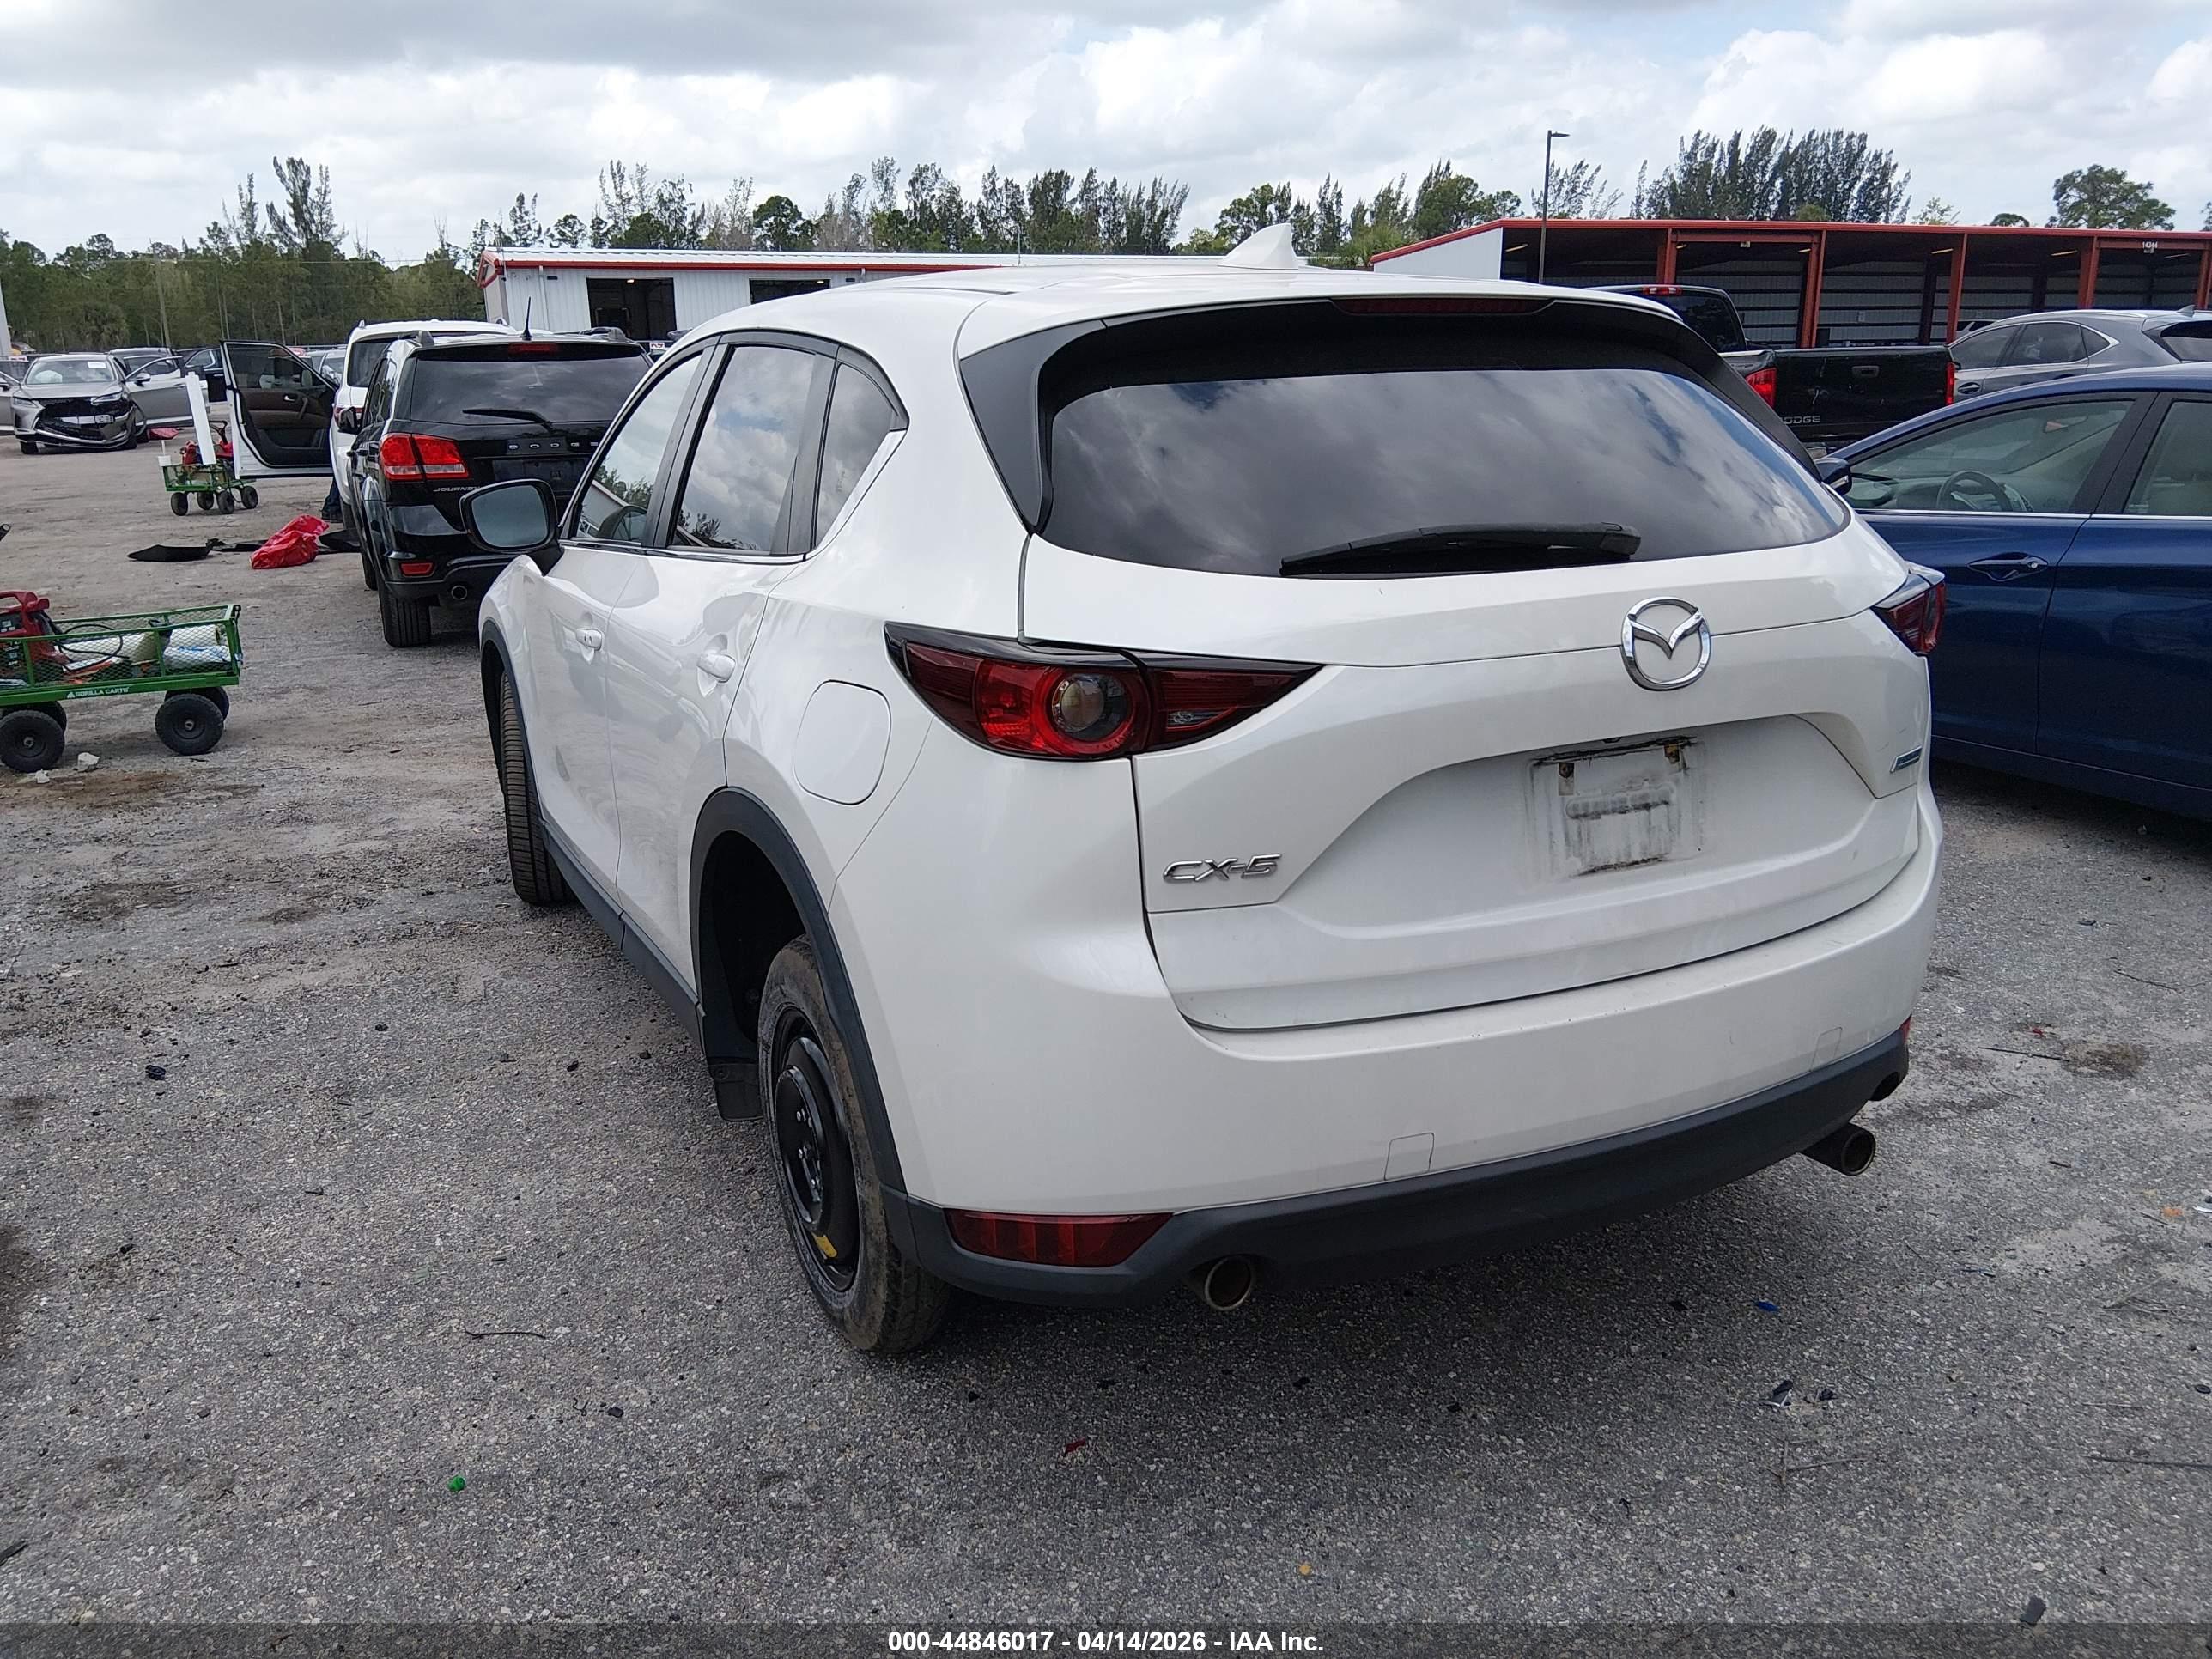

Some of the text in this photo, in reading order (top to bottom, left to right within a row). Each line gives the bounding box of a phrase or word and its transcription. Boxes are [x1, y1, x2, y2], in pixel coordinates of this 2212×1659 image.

[1780, 416, 1820, 424] ODGE
[75, 689, 104, 698] GORILLA
[1164, 854, 1282, 883] CX-5
